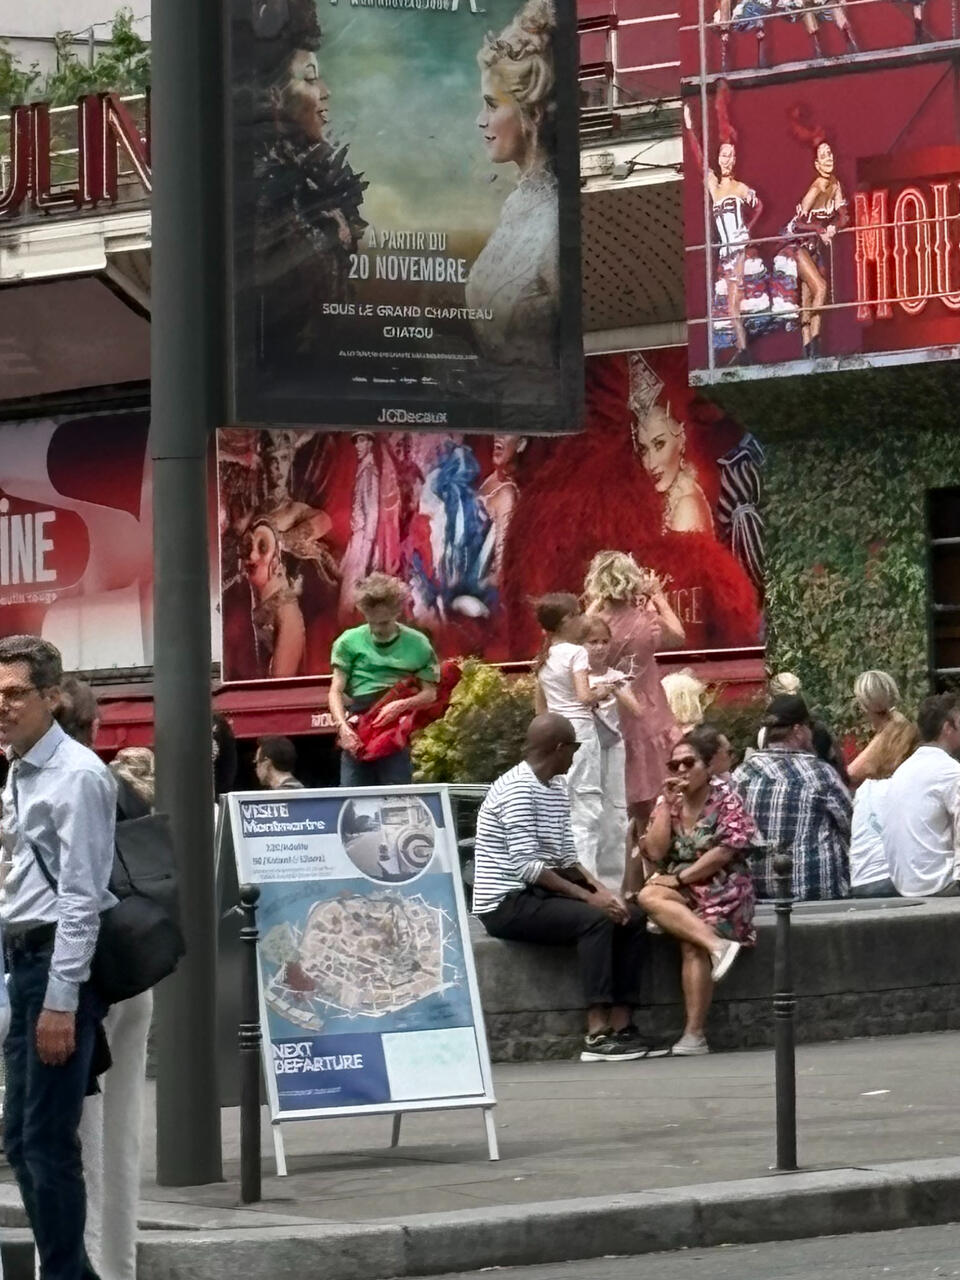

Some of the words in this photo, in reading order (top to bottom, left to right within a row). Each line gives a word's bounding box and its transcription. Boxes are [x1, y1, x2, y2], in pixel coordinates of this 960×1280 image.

[380, 230, 425, 250] PARTIR
[429, 232, 447, 251] DU
[348, 253, 370, 280] 20
[375, 254, 467, 283] NOVEMBRE
[322, 303, 356, 316] SOUS
[359, 304, 374, 316] LE
[377, 305, 421, 317] GRAND
[424, 307, 493, 320] CHAPITEAU
[241, 803, 290, 819] VISITE
[243, 818, 326, 833] Montmartre
[271, 1041, 313, 1058] NEXT
[274, 1053, 364, 1074] DEPARTURE
